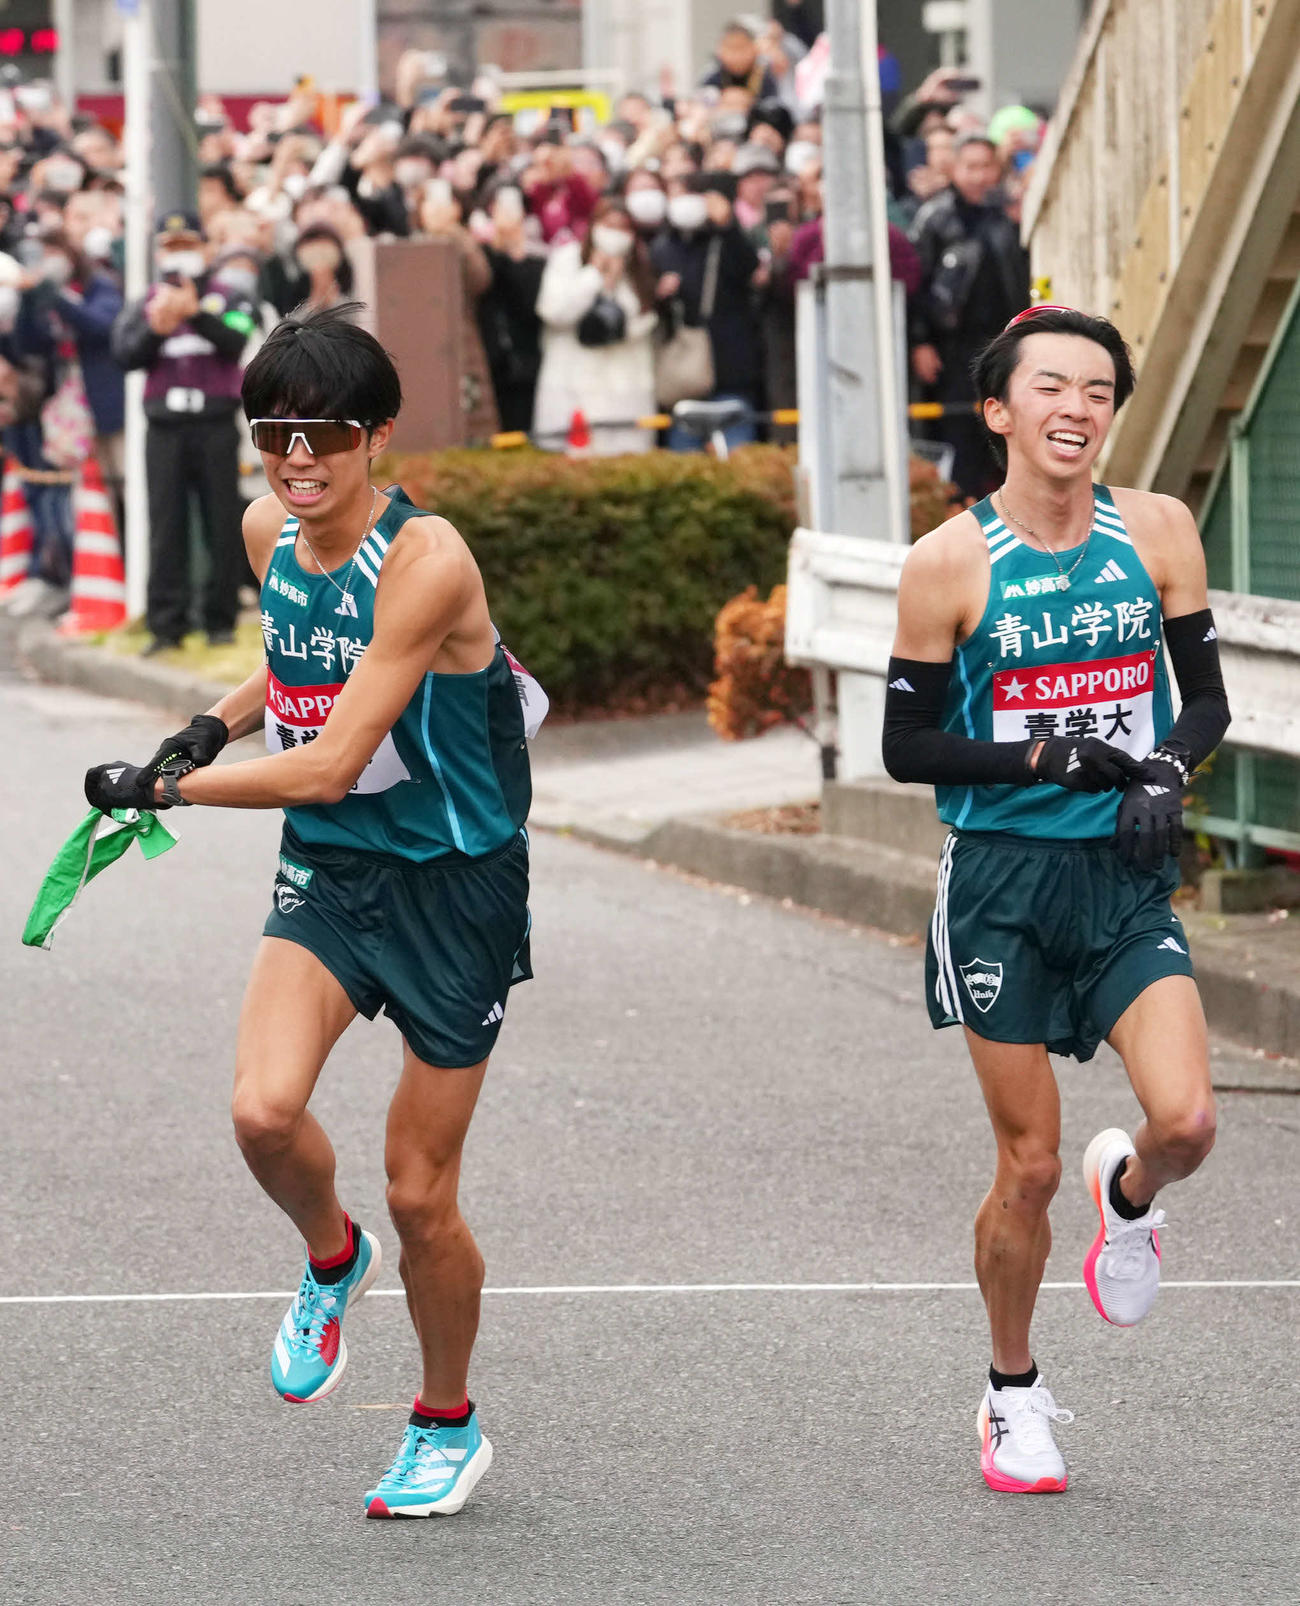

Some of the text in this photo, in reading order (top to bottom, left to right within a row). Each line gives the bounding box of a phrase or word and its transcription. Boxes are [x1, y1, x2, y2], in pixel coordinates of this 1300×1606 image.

[988, 597, 1153, 658] 青山学院
[1035, 661, 1149, 701] SAPPORO
[276, 690, 340, 719] SAPP
[1024, 703, 1133, 741] 青学大
